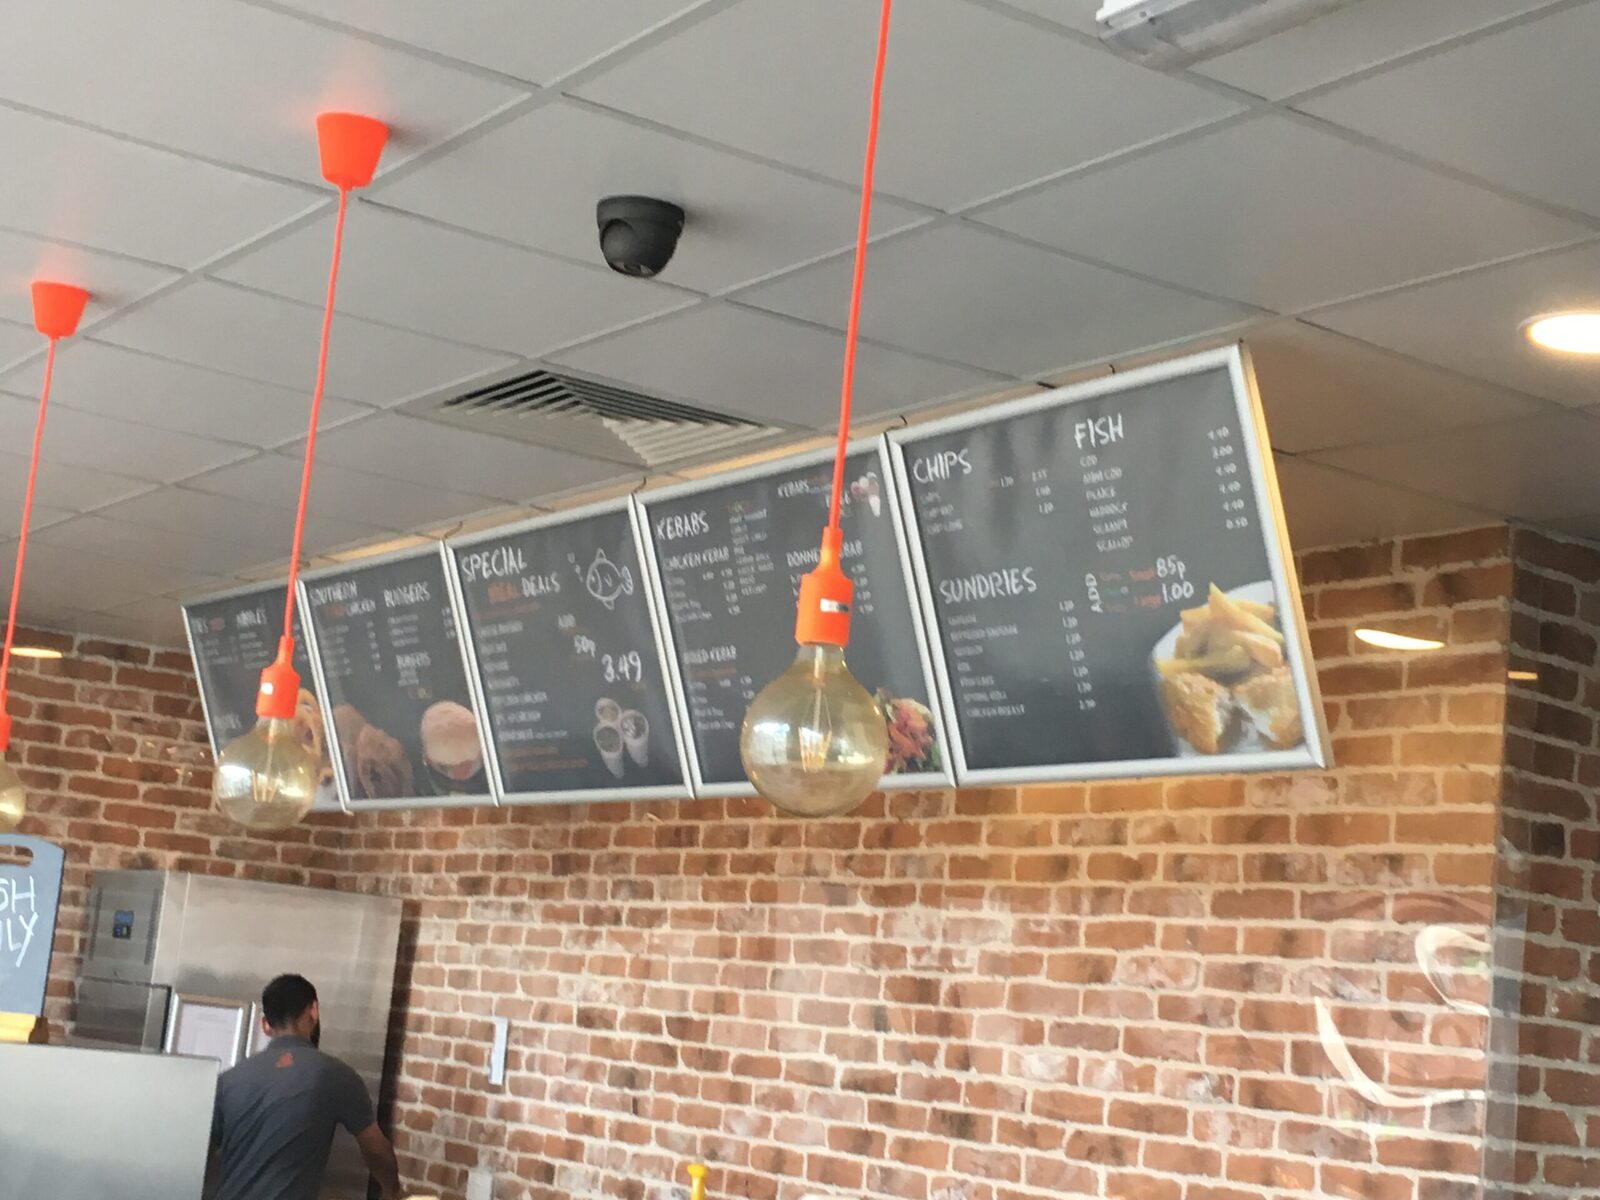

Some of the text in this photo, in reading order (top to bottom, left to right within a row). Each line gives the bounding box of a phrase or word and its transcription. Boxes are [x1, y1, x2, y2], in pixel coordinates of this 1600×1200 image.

[1074, 412, 1125, 449] FISH
[913, 448, 972, 484] CHIPS
[656, 510, 710, 540] KEBABS
[461, 545, 528, 583] SPECIAL
[1156, 554, 1187, 580] 85p
[521, 571, 561, 598] DEALS
[939, 566, 1037, 604] SUNDRIES
[1162, 581, 1194, 604] 1.00
[601, 650, 642, 683] 3.49
